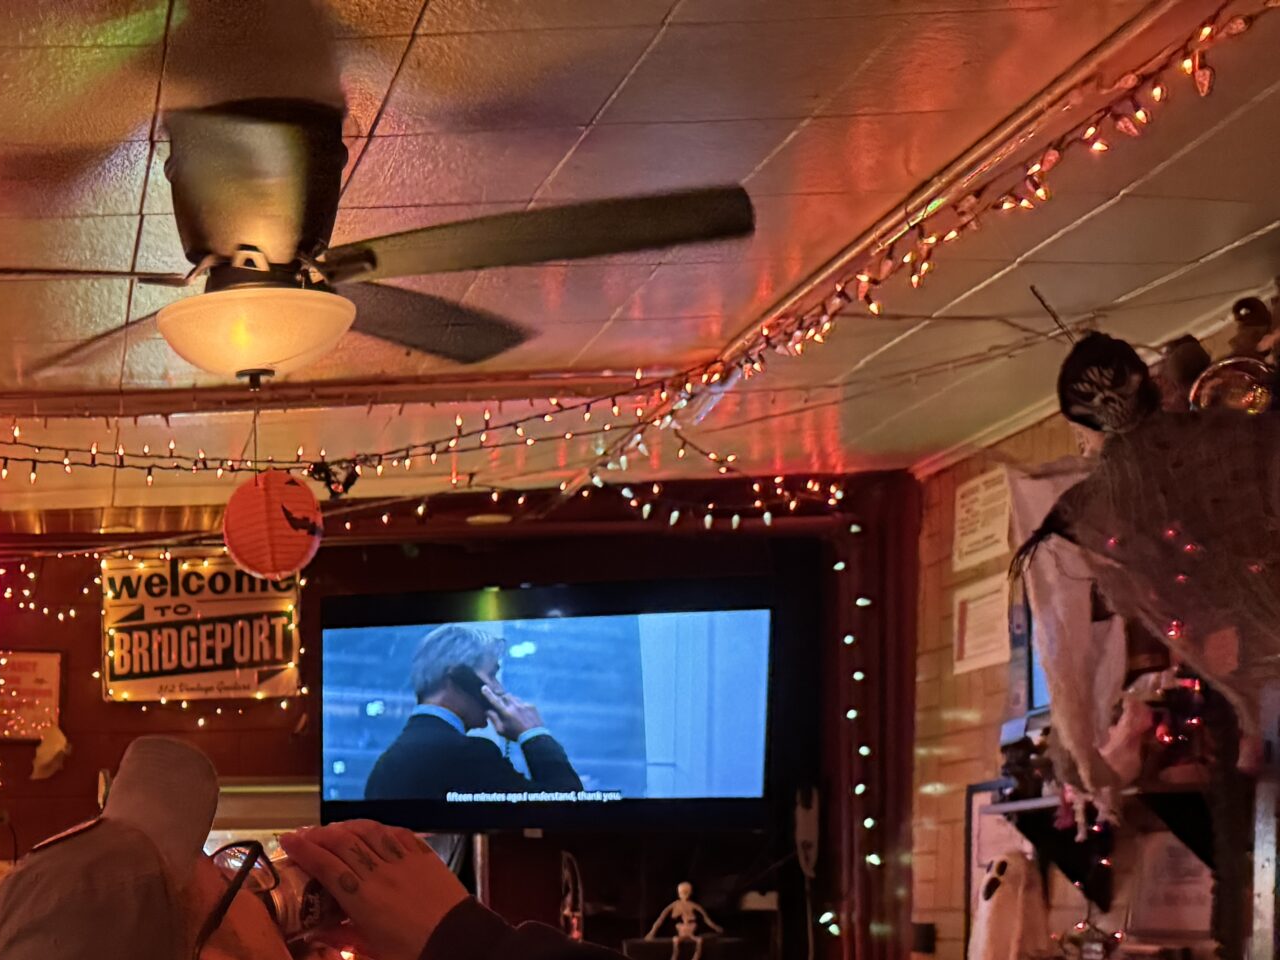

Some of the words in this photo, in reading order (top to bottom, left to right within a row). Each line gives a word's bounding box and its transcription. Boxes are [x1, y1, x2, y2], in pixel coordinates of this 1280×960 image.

[154, 603, 192, 618] TO
[113, 616, 289, 676] BRIDGEPORT
[474, 792, 505, 802] minutes
[577, 791, 601, 802] thank
